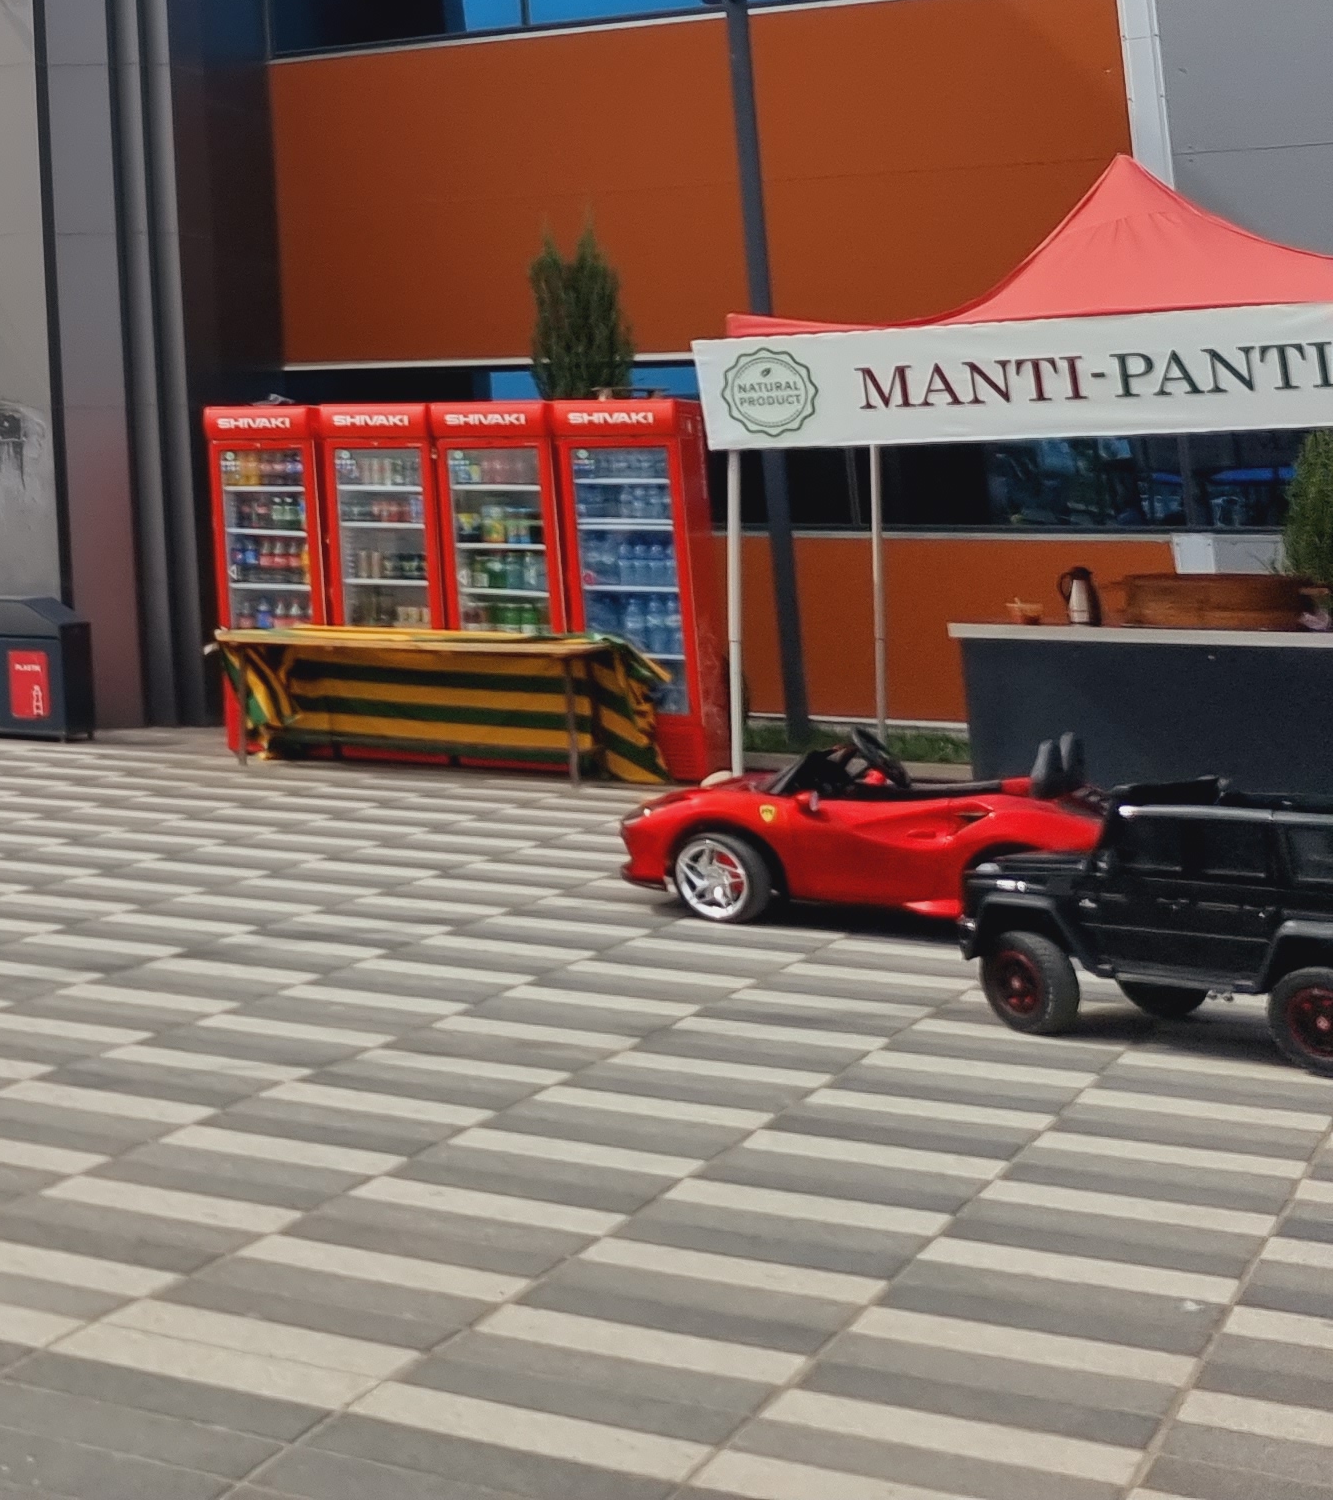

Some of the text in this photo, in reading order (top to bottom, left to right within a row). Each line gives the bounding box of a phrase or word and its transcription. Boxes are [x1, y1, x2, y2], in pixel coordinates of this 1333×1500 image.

[854, 341, 1333, 410] MANTI-PANTI
[737, 381, 800, 393] NATURAL
[739, 394, 801, 407] PRODUCT
[217, 417, 290, 429] SHIVAKI
[333, 414, 409, 426] SHIVAKI
[444, 413, 526, 426] SHIVAKI
[567, 411, 654, 424] SHIVAKI
